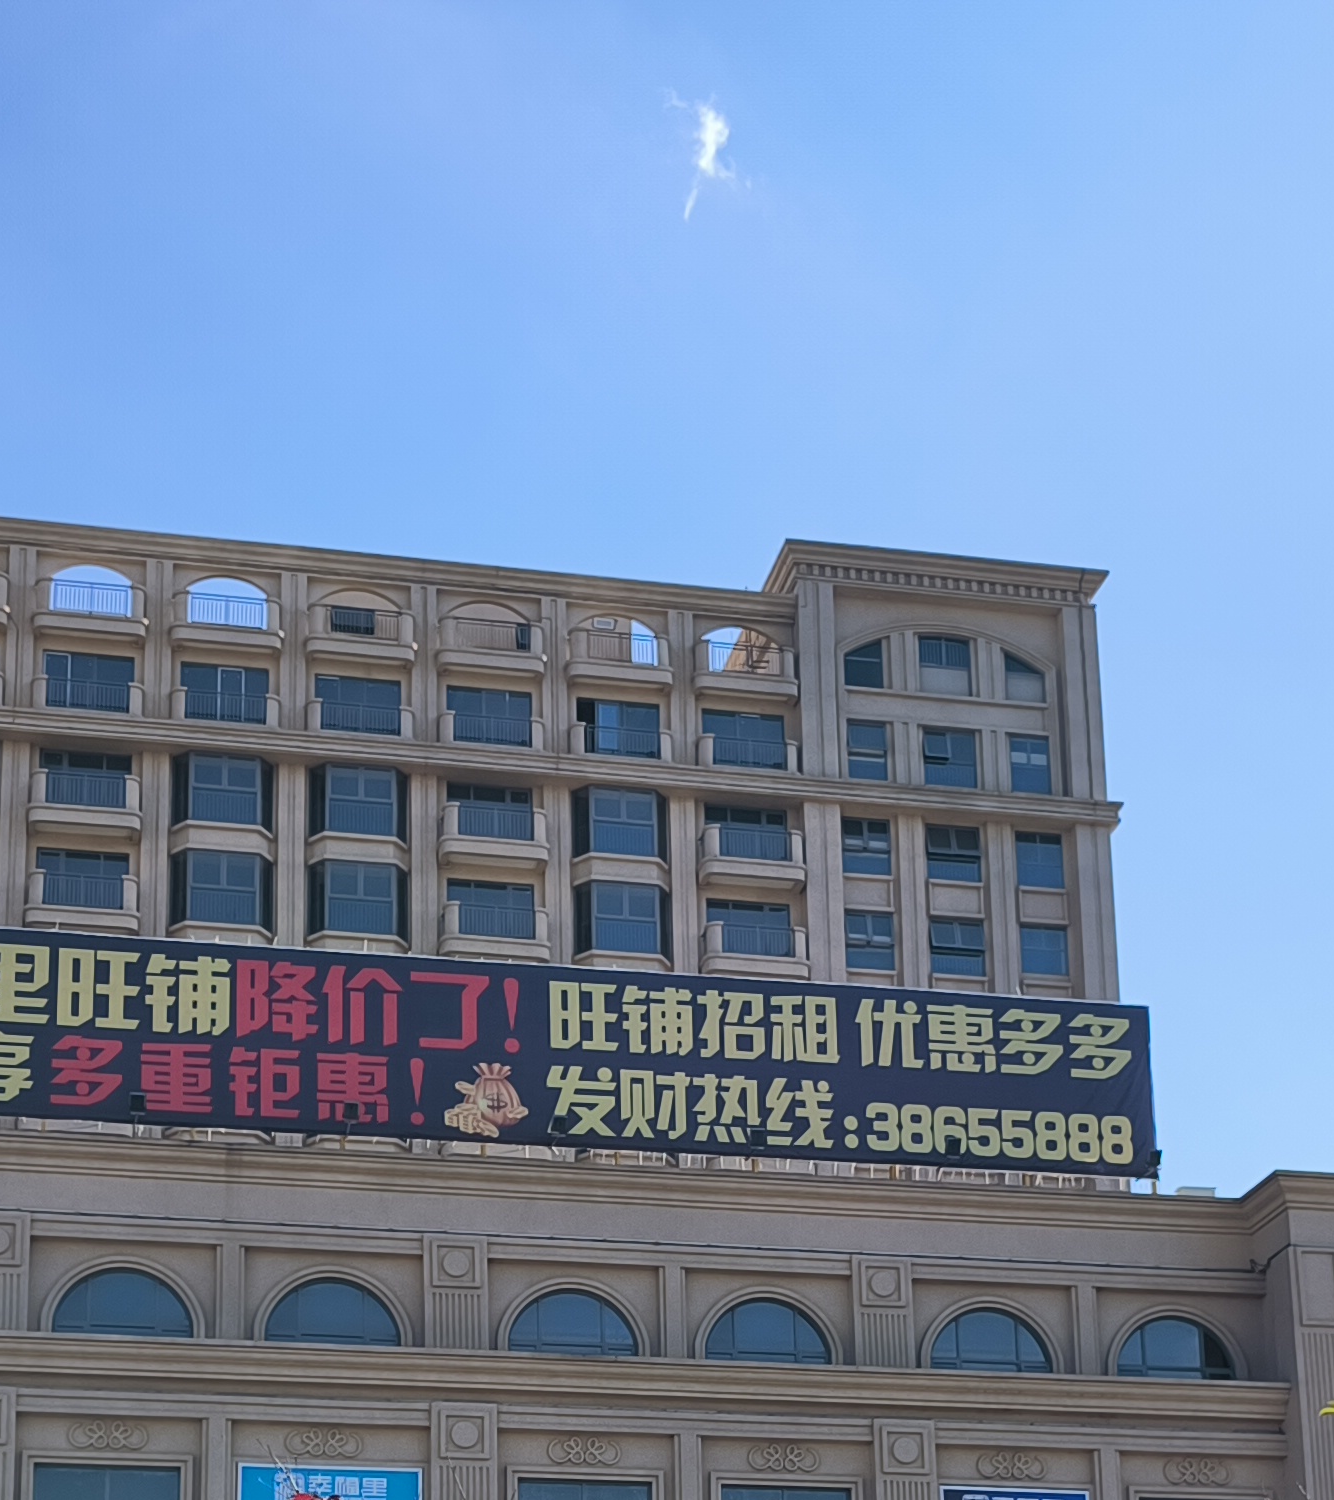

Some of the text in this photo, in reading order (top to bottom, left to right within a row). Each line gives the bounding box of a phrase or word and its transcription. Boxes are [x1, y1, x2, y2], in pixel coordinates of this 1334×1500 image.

[548, 979, 839, 1065] 旺铺招租
[856, 1000, 1131, 1080] 优惠多多
